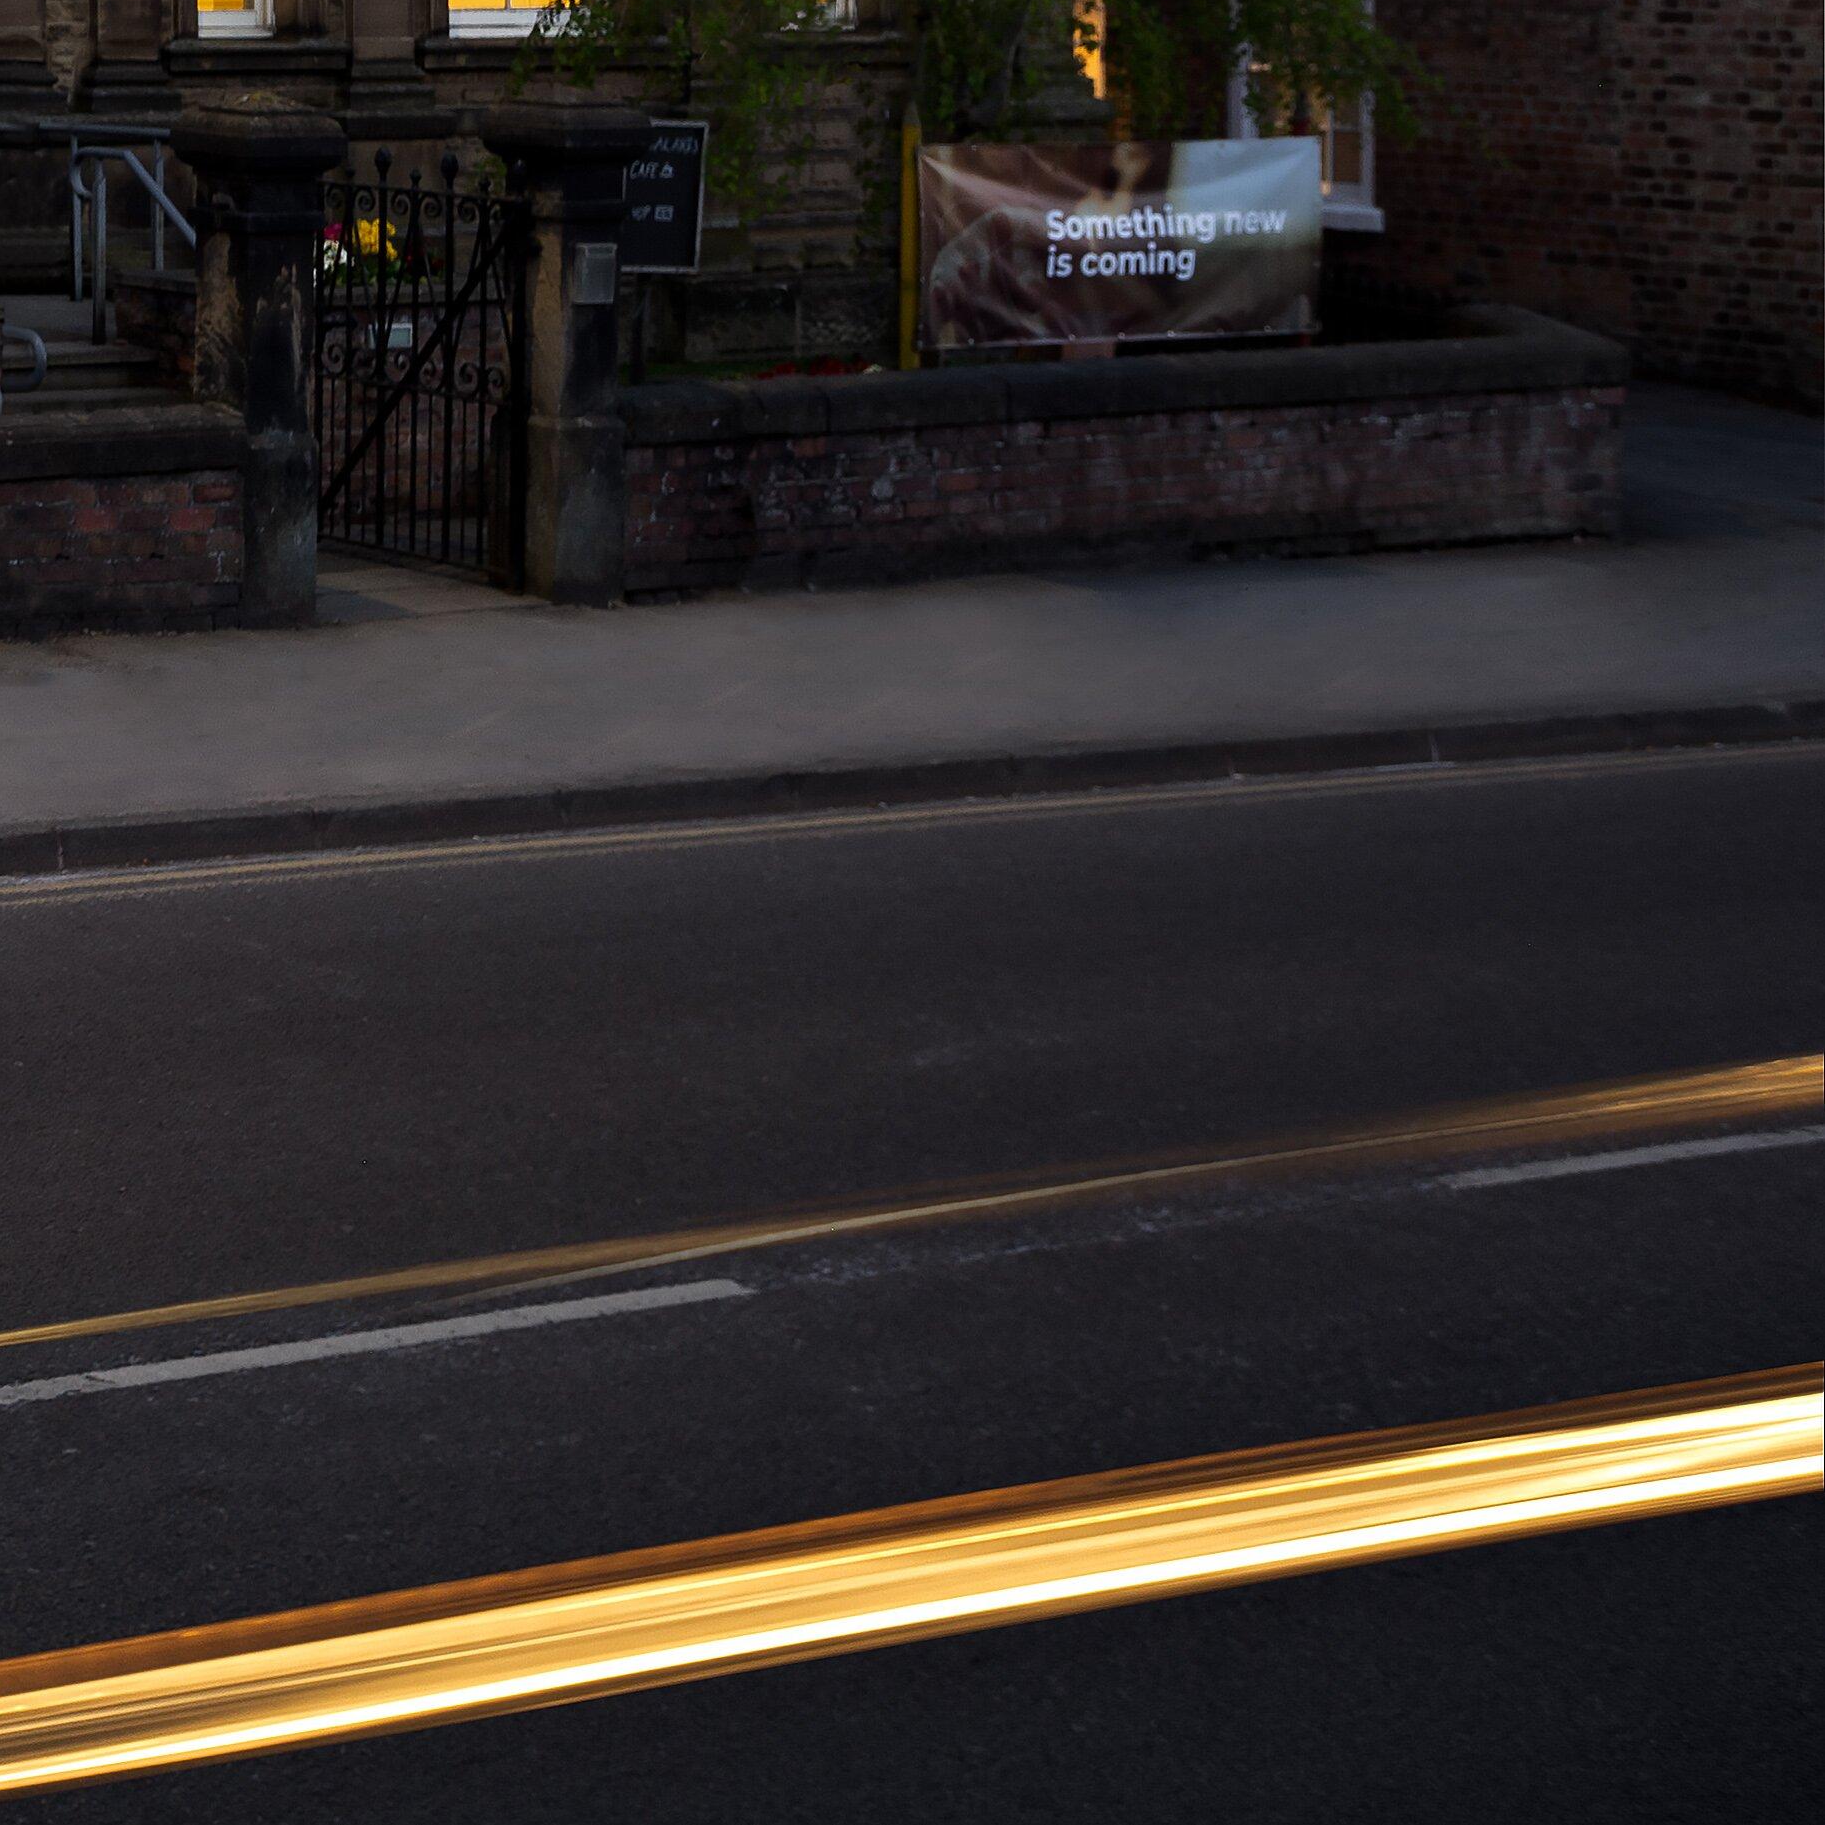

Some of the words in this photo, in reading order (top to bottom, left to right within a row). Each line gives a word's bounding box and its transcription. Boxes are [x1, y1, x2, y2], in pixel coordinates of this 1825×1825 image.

[1046, 202, 1216, 245] Something
[1222, 208, 1288, 234] new
[1045, 245, 1073, 279] is
[1079, 242, 1197, 281] coming
